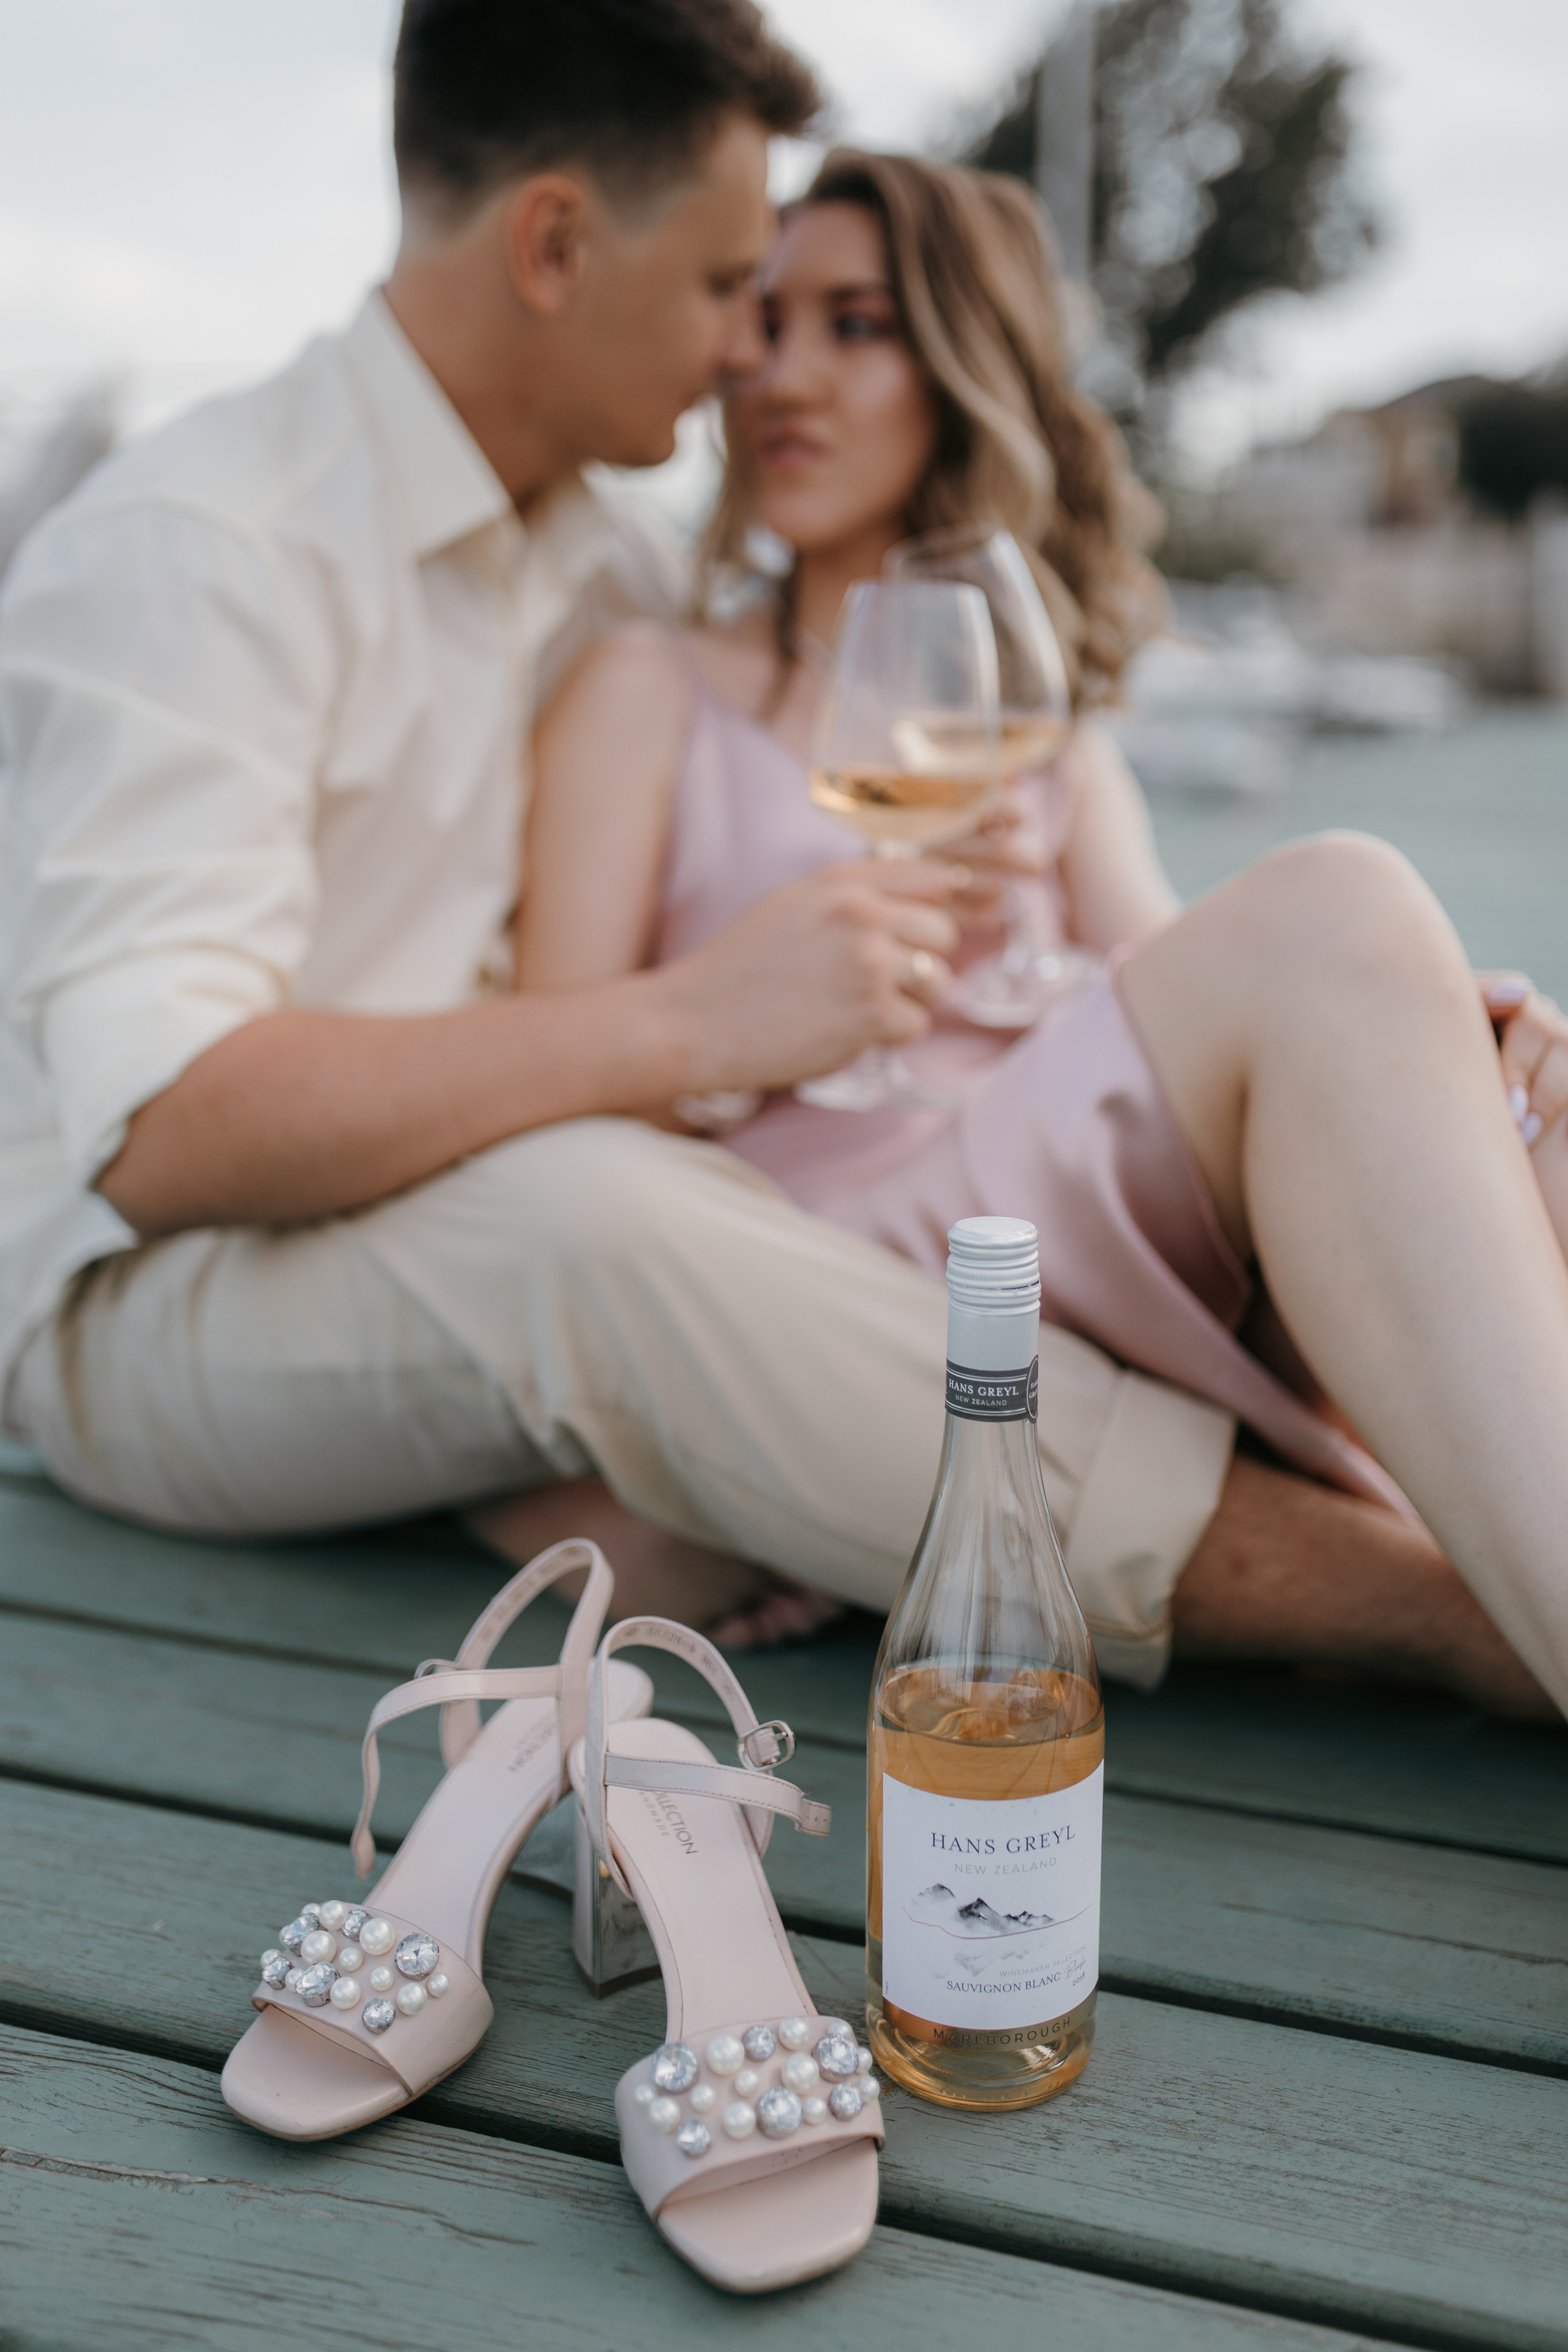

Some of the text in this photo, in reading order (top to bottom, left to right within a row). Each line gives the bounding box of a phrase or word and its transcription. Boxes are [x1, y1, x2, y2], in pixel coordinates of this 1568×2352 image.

[949, 1378, 974, 1395] HANS
[978, 1386, 1019, 1396] GREYL
[956, 1394, 970, 1403] NEW
[638, 1791, 670, 1836] ANDMADE
[931, 1825, 1076, 1854] HANS GREYL
[955, 1856, 1057, 1875] NEW ZEALAND
[1000, 1944, 1086, 1977] WINEMAKER SELECTION
[947, 1972, 1061, 1993] SAUVIGNON BLANC
[1072, 1971, 1085, 1986] 2018
[933, 2016, 1071, 2045] MARLBOROUGH
